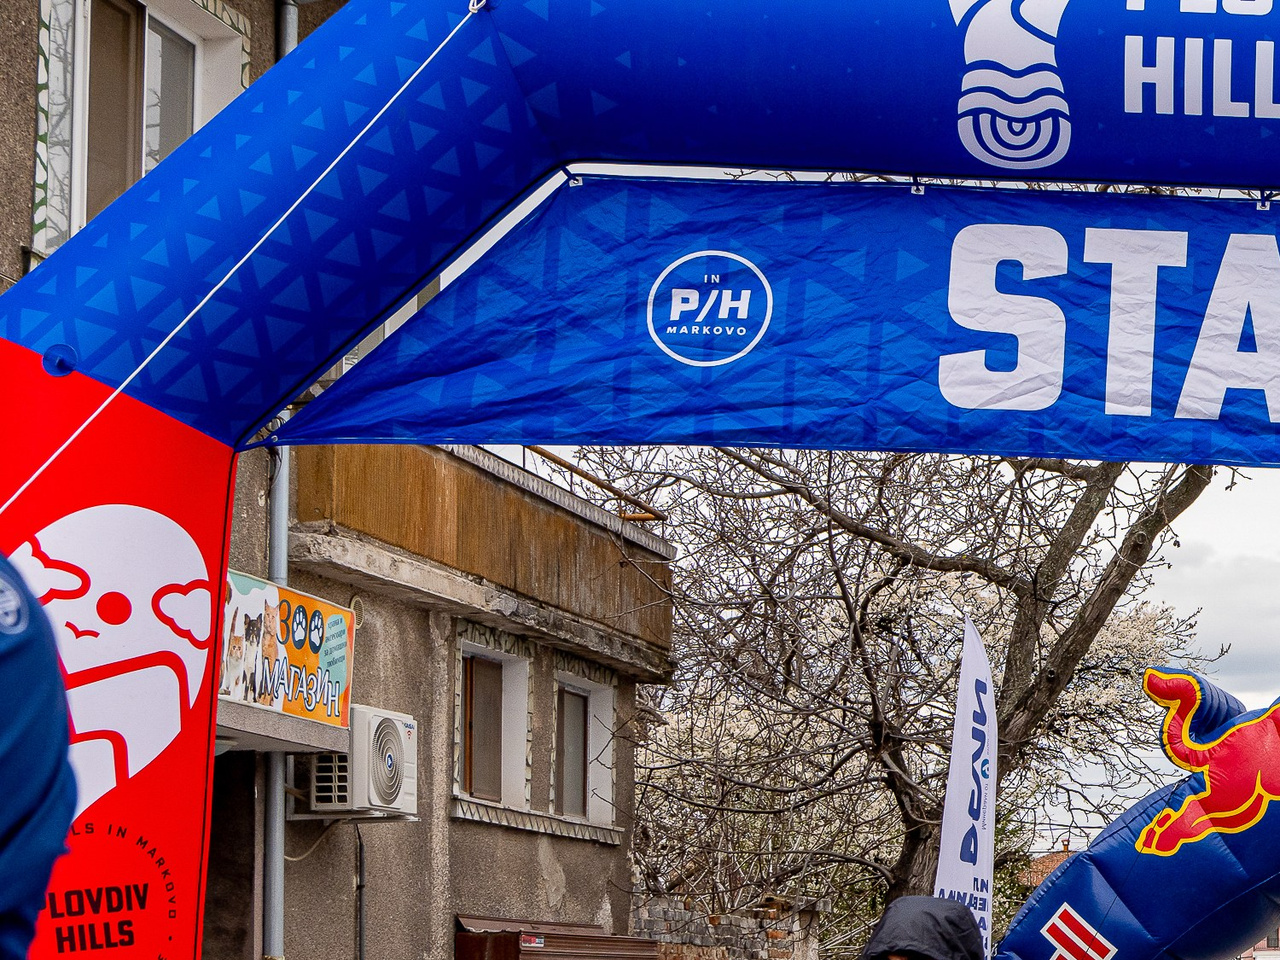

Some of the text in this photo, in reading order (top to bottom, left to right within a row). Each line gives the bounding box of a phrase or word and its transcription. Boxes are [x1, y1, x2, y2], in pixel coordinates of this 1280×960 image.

[704, 274, 720, 283] IN
[669, 288, 751, 323] P/H
[666, 325, 747, 336] MARKOVO
[262, 656, 340, 717] МАГАЗИН
[108, 824, 177, 919] IN MARKOVO
[48, 883, 148, 919] LOVDIV
[55, 920, 135, 953] HILLS
